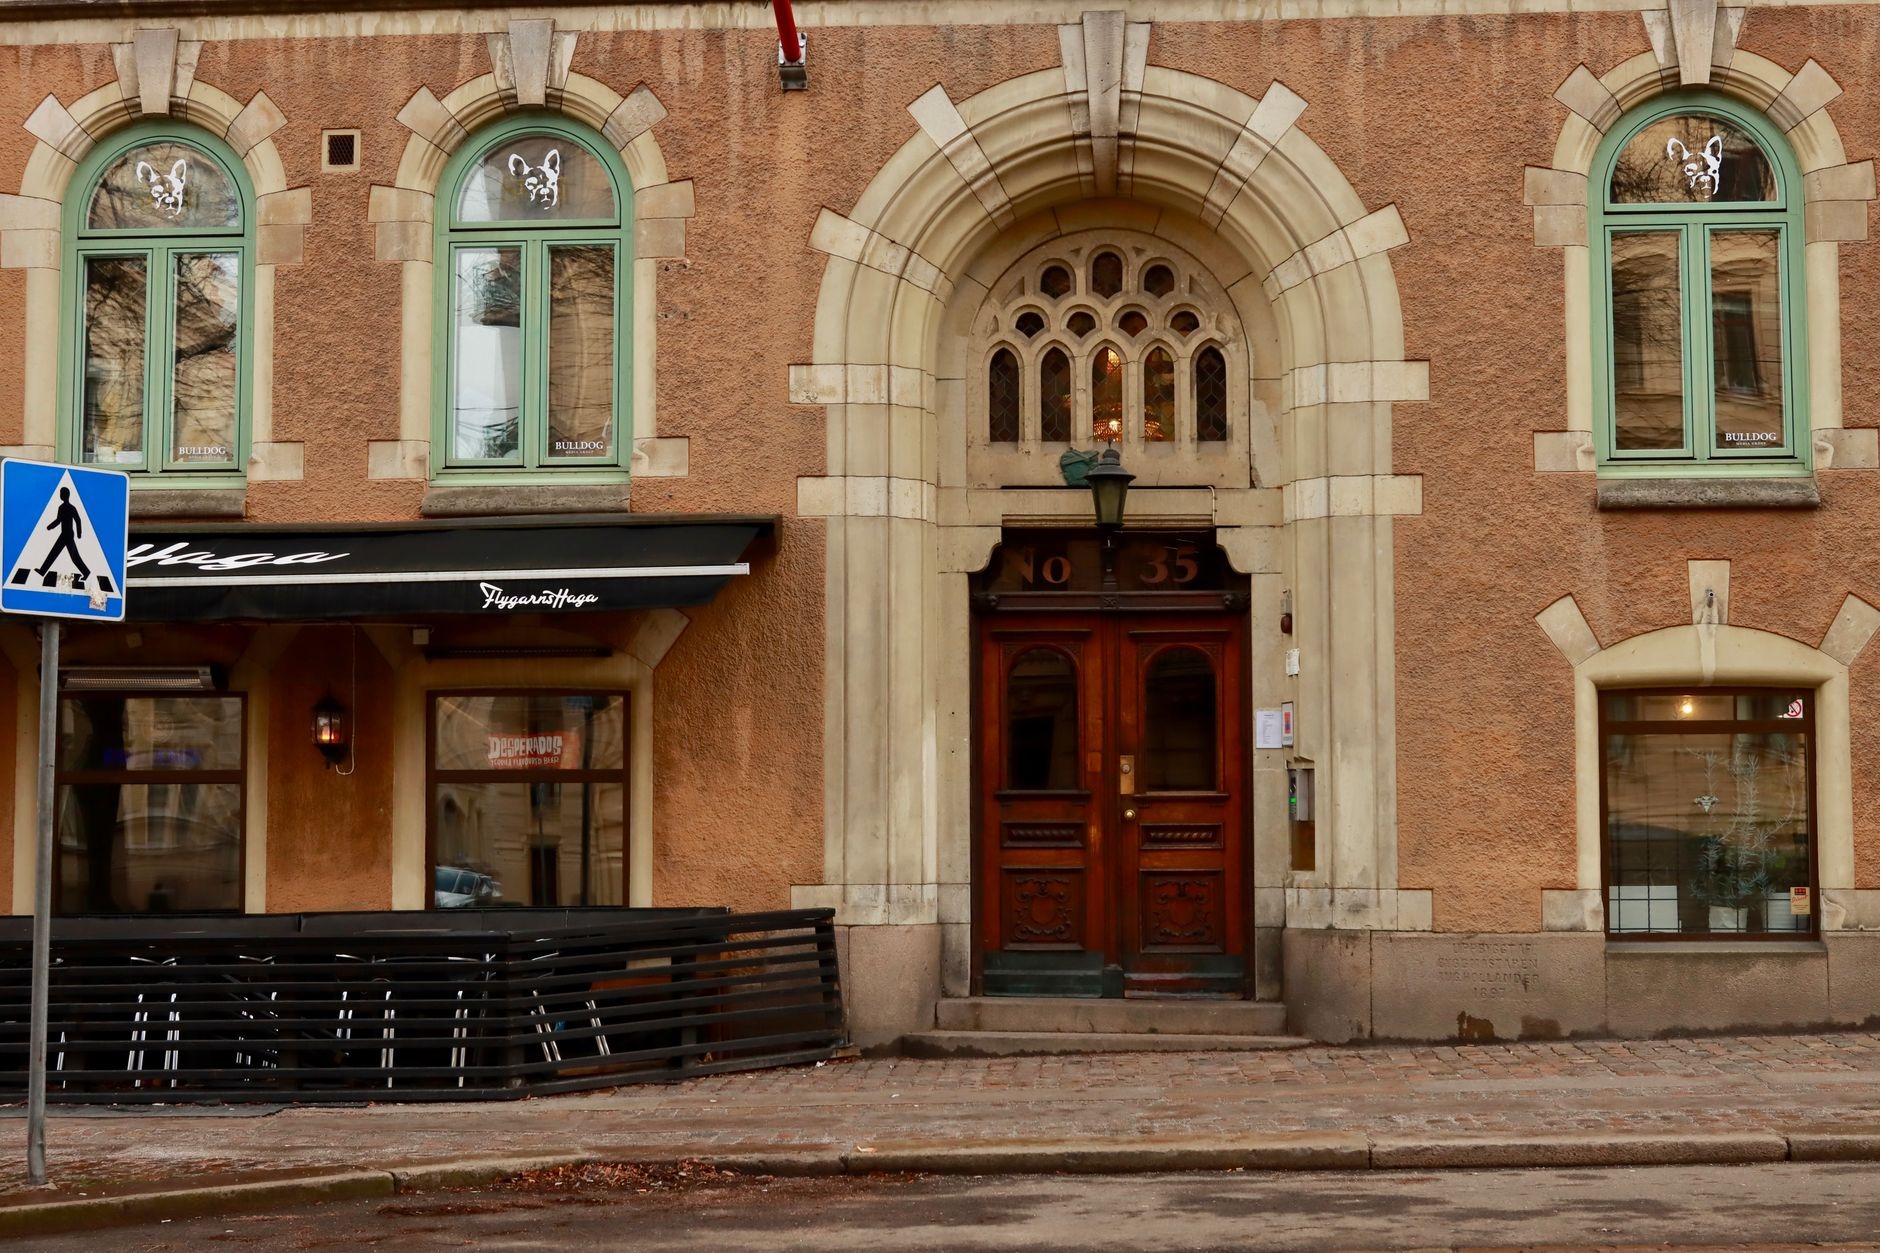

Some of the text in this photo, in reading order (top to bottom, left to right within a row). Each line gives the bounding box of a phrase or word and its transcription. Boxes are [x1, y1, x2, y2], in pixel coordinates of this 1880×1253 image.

[1725, 432, 1777, 441] BULLDOG
[555, 441, 604, 450] BULLDOG
[178, 446, 226, 455] BULLDOG
[1139, 546, 1198, 585] 35
